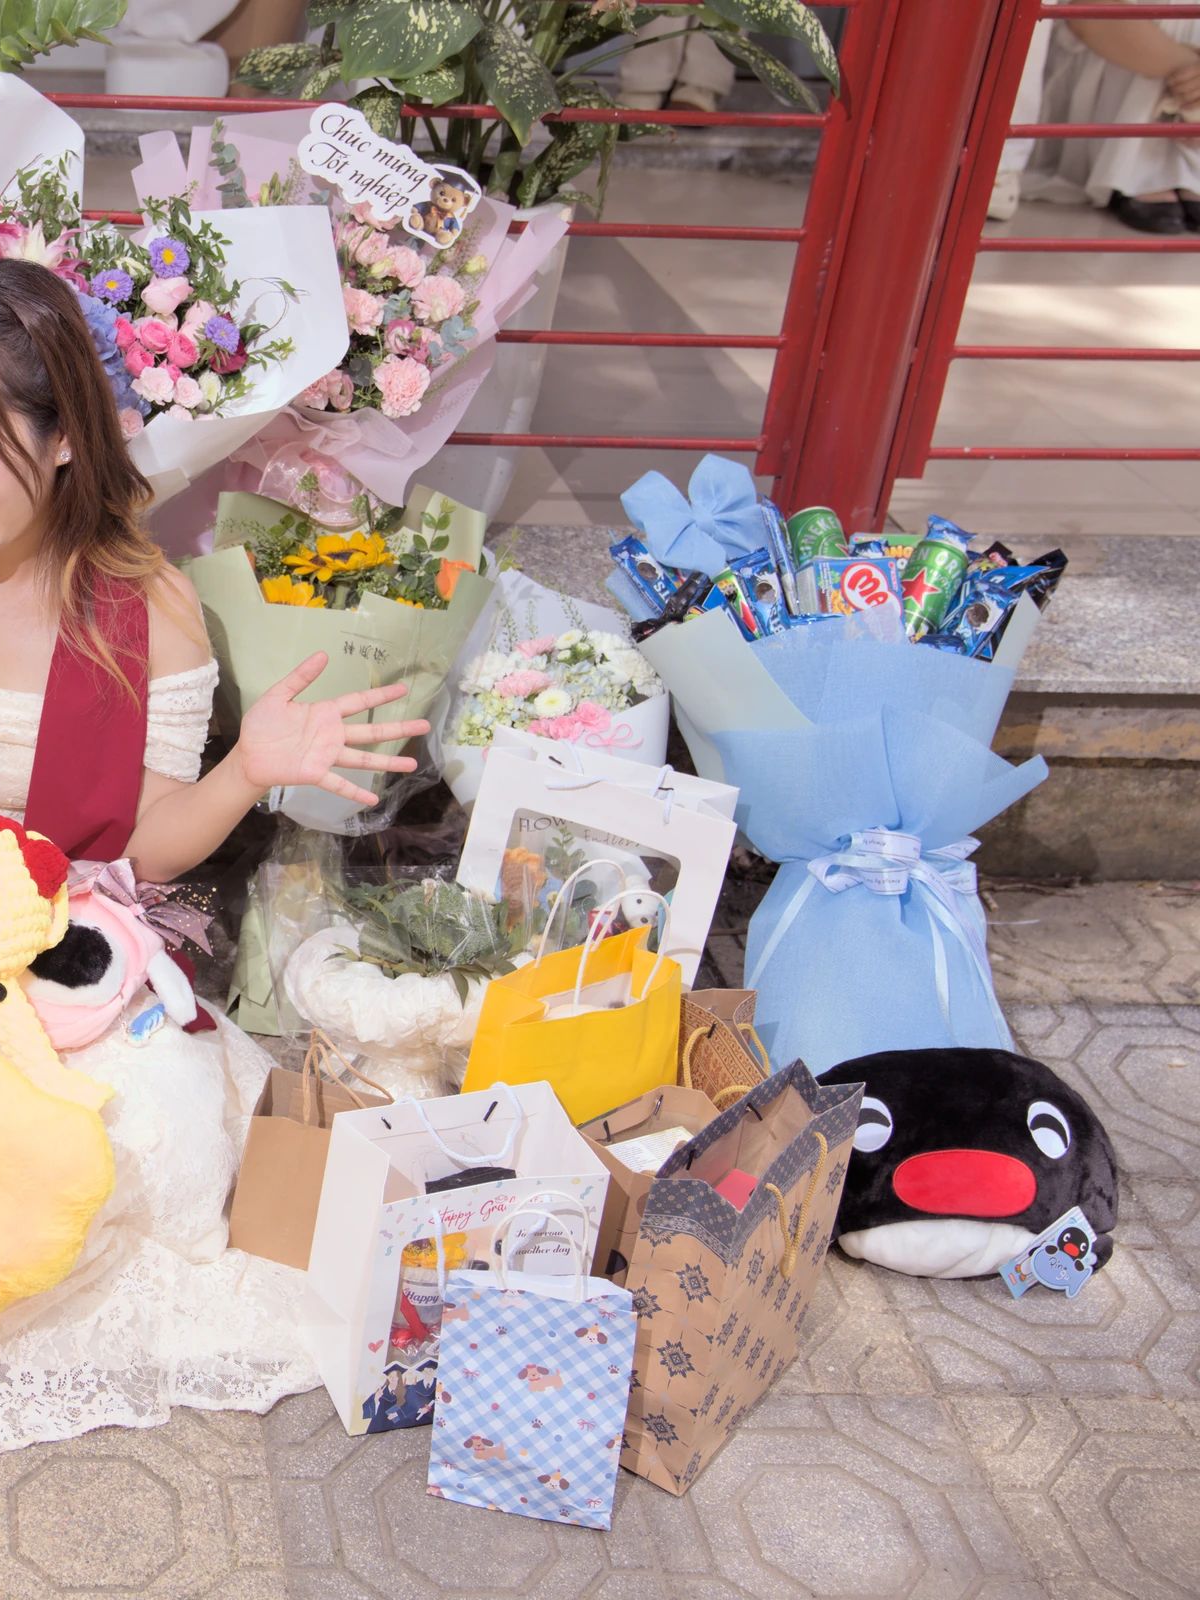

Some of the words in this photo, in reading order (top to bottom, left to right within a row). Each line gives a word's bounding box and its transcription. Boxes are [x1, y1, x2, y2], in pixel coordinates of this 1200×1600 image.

[320, 114, 371, 153] Chúc
[372, 148, 428, 193] mừng
[349, 169, 410, 214] nghiệp
[515, 1244, 551, 1256] another
[553, 1244, 571, 1257] day
[405, 1290, 440, 1305] Happy
